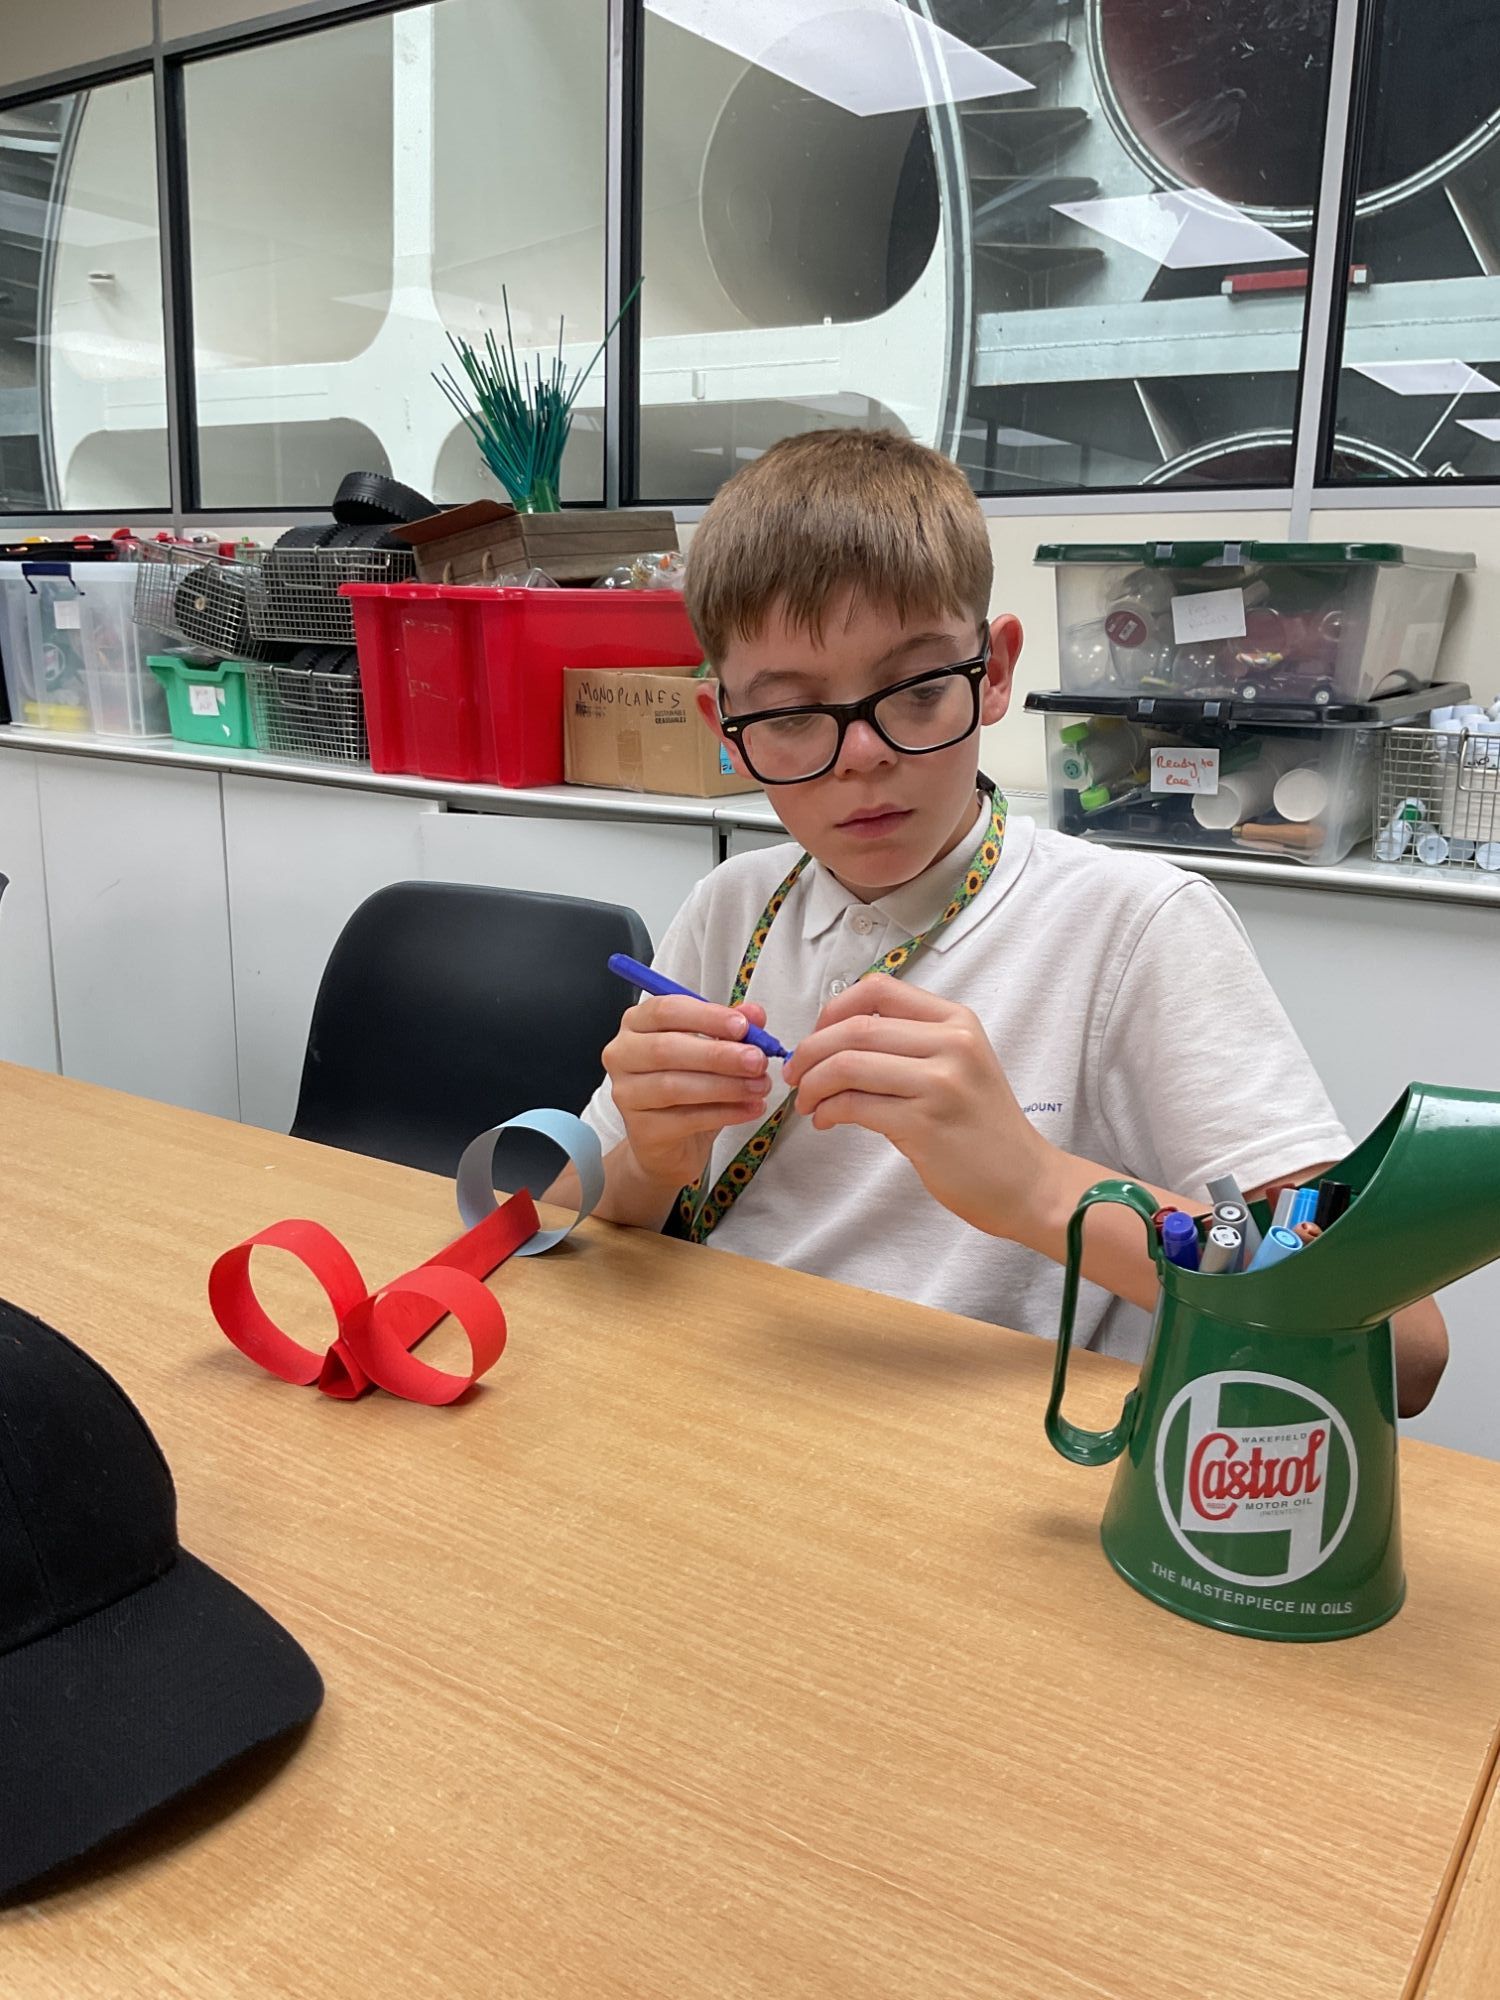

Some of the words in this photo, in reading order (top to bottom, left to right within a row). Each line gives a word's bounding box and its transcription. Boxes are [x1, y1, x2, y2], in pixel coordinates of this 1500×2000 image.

[578, 682, 681, 709] MONOPLANES
[1157, 756, 1197, 778] Ready
[1201, 758, 1214, 768] to
[1242, 1433, 1307, 1443] WAKEFIELD
[1189, 1429, 1326, 1521] Castrol
[1245, 1500, 1288, 1510] MOTOR
[1293, 1498, 1313, 1506] OIL
[1151, 1561, 1176, 1583] THE
[1181, 1576, 1295, 1613] MASTERPIECE
[1300, 1602, 1316, 1614] IN
[1321, 1601, 1353, 1614] OILS
